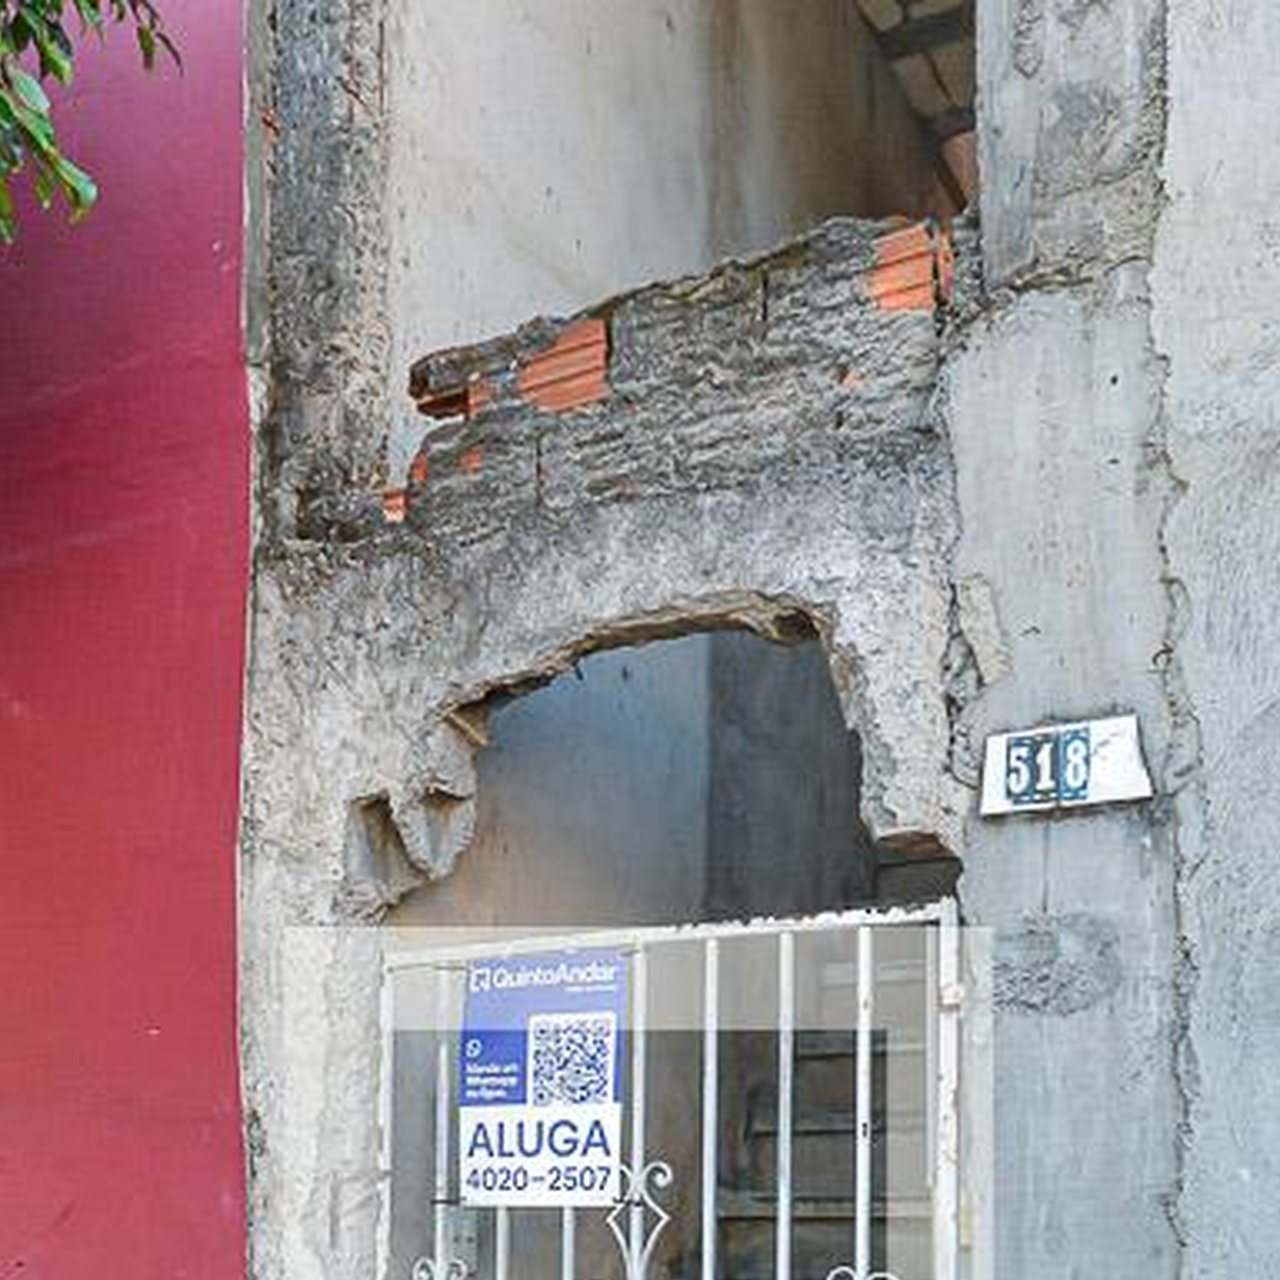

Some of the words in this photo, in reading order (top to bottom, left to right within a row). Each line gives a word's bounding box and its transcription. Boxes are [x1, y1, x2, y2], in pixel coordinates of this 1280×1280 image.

[1008, 740, 1088, 794] 518
[493, 962, 616, 988] QuintoAndar
[468, 1119, 611, 1158] ALUGA
[467, 1166, 611, 1192] 4020-2507
